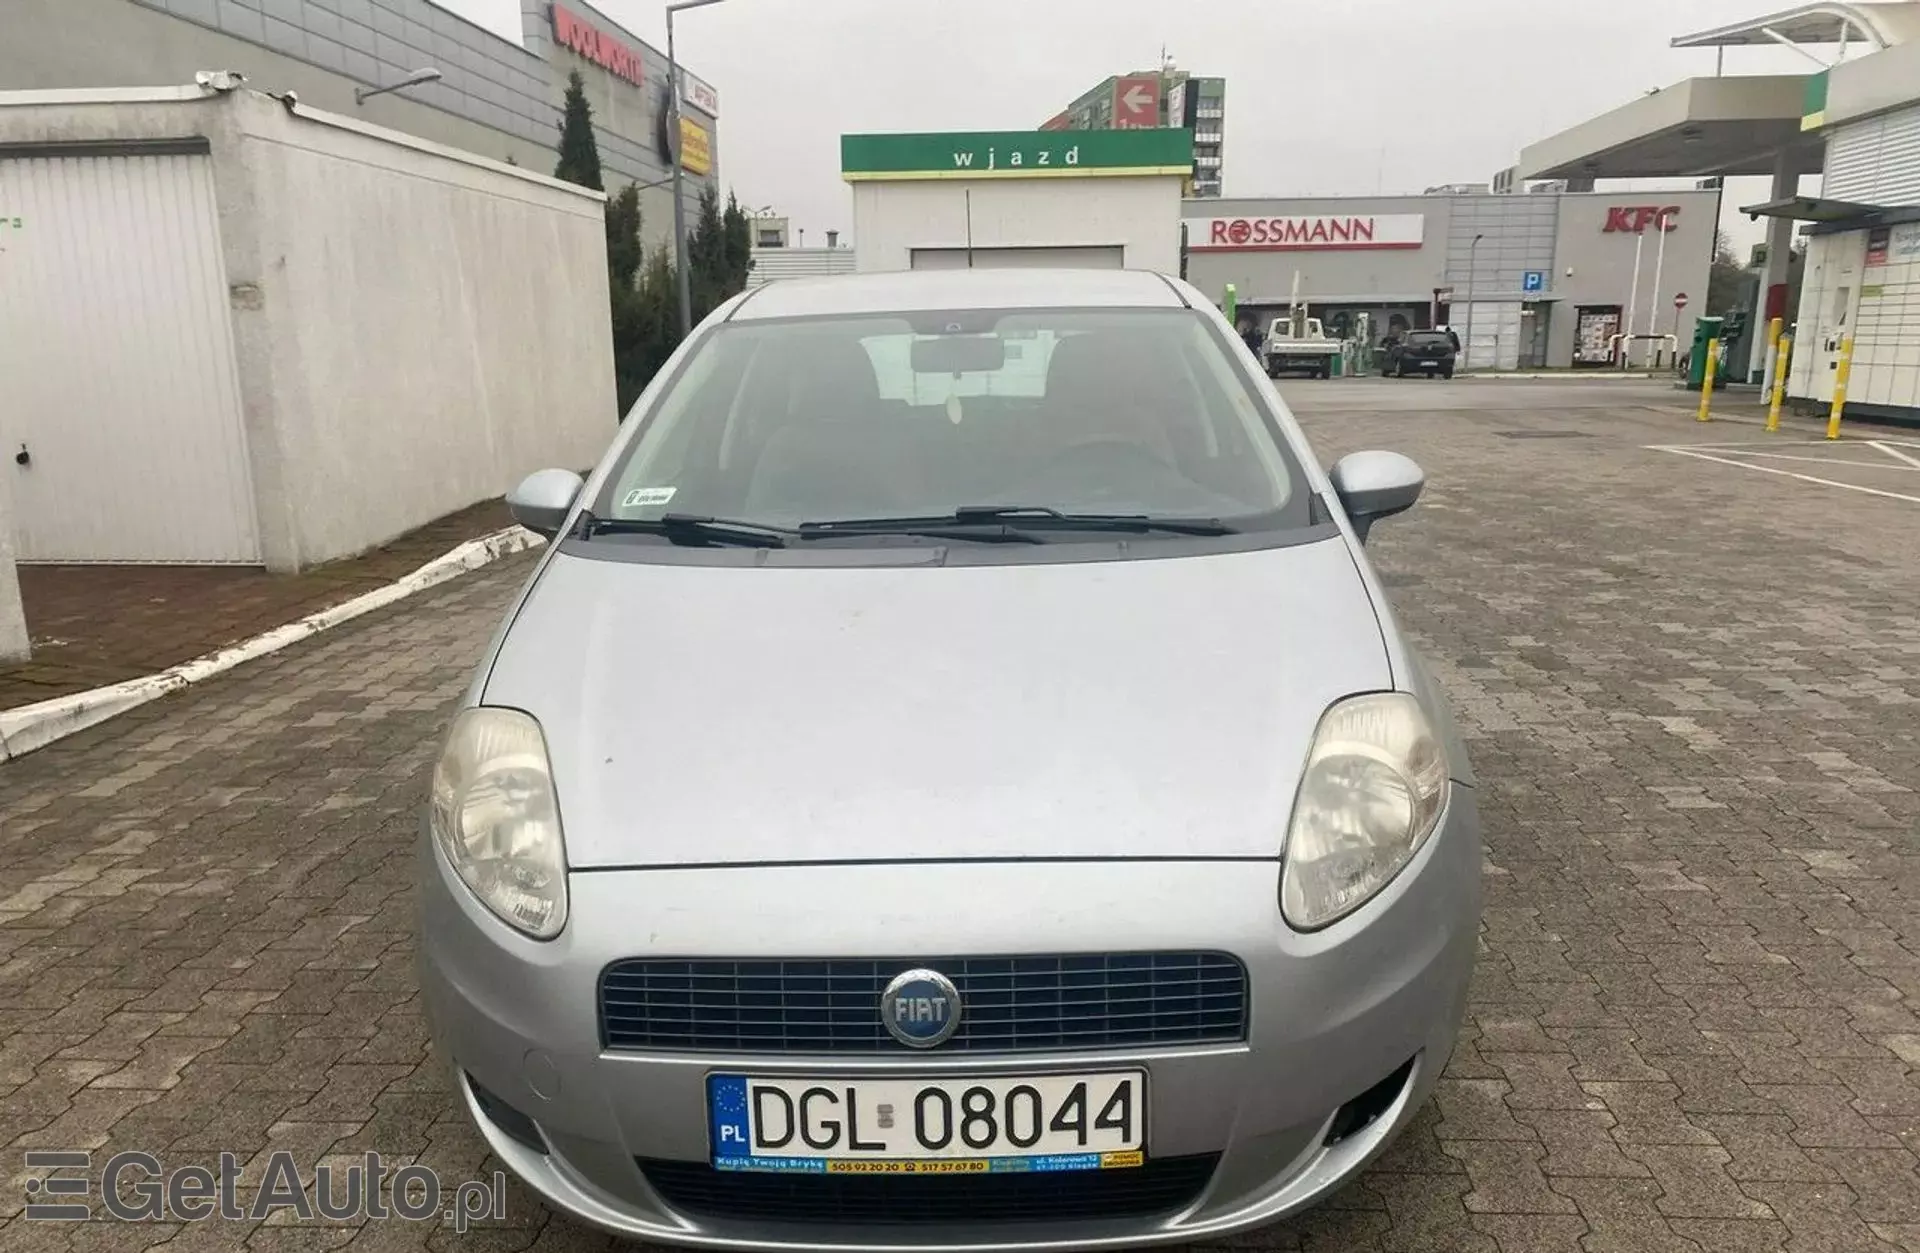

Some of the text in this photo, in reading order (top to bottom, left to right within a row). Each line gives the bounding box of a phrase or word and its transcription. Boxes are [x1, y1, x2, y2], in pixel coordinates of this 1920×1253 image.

[552, 3, 645, 87] WOOLWORTH
[1211, 217, 1374, 244] ROSSMANN
[1602, 206, 1681, 233] KFC
[895, 997, 946, 1022] FIAT
[753, 1079, 1132, 1151] DGL 08044
[721, 1125, 746, 1143] PL
